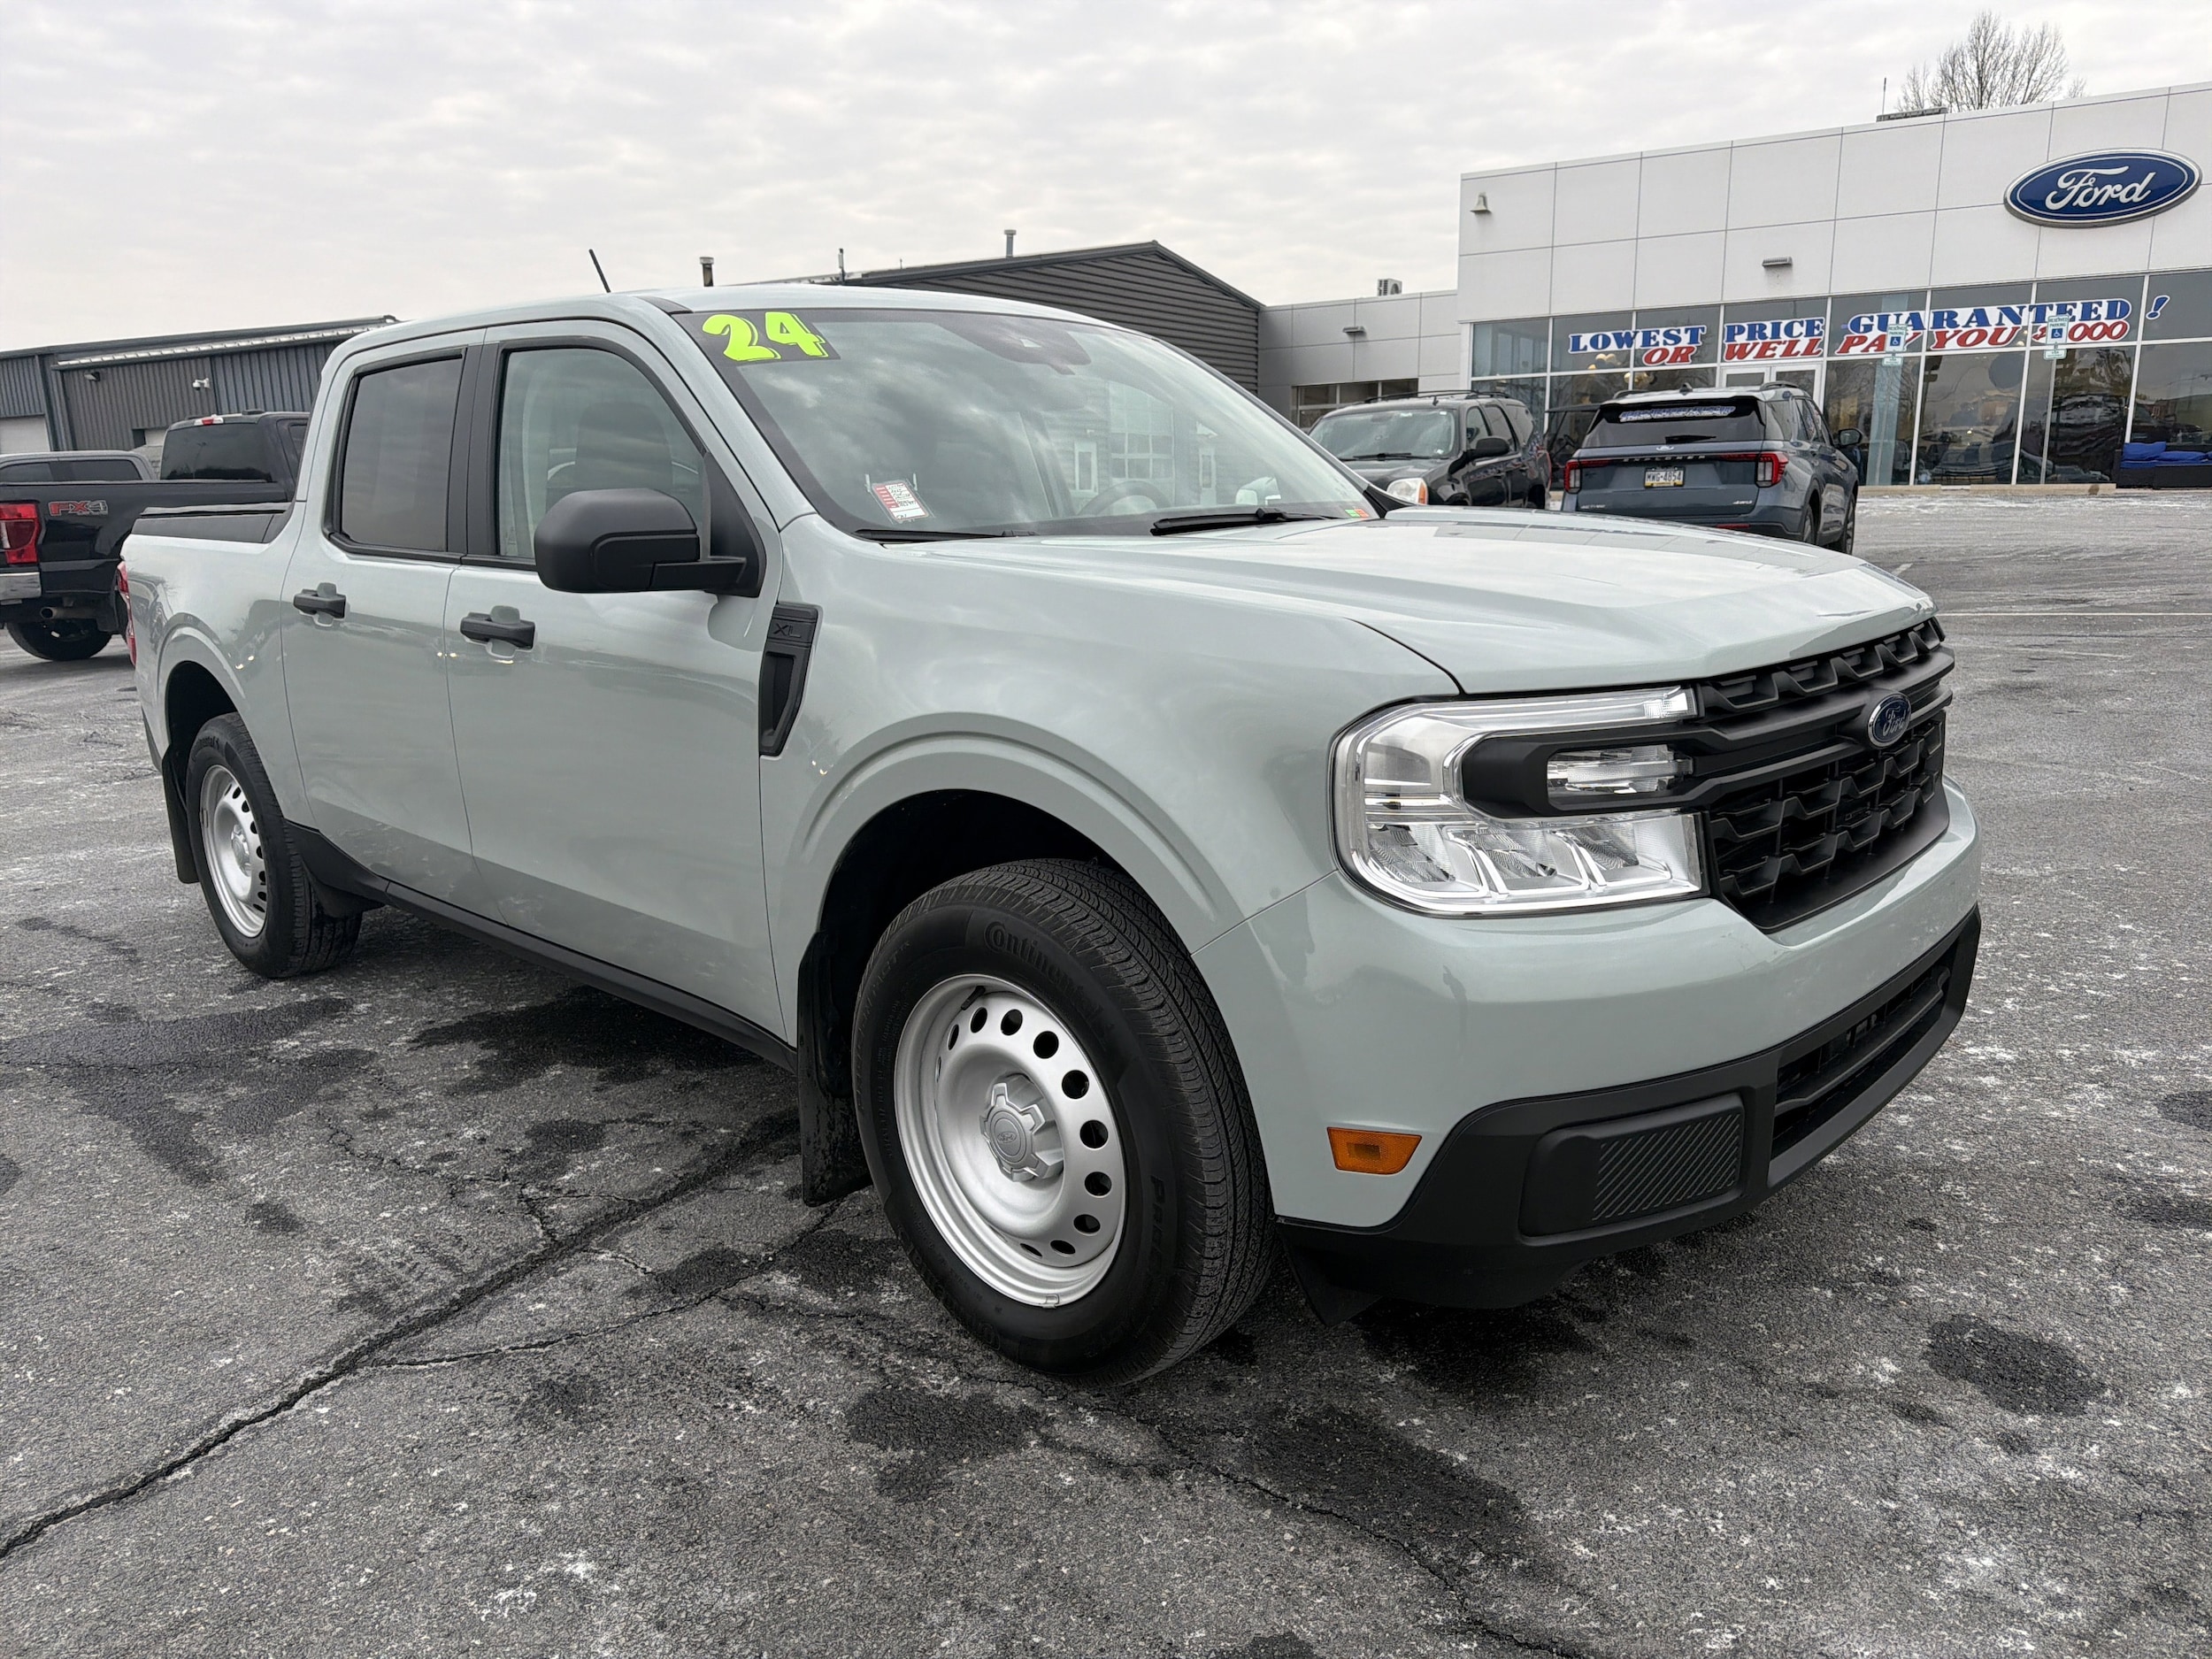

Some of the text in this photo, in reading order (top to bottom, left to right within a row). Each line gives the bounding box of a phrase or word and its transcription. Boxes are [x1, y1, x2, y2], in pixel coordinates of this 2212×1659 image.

[2045, 165, 2157, 211] Ford
[703, 311, 828, 361] 24
[1569, 326, 1706, 353] LOWEST
[1724, 318, 1824, 343] PRICE
[1642, 345, 1697, 365] OR
[1724, 337, 1823, 361] WE'LL
[1929, 326, 2022, 350] YOU
[2032, 320, 2129, 343] $000
[48, 500, 108, 516] FX4
[773, 622, 801, 638] XL
[1882, 705, 1907, 737] Ford
